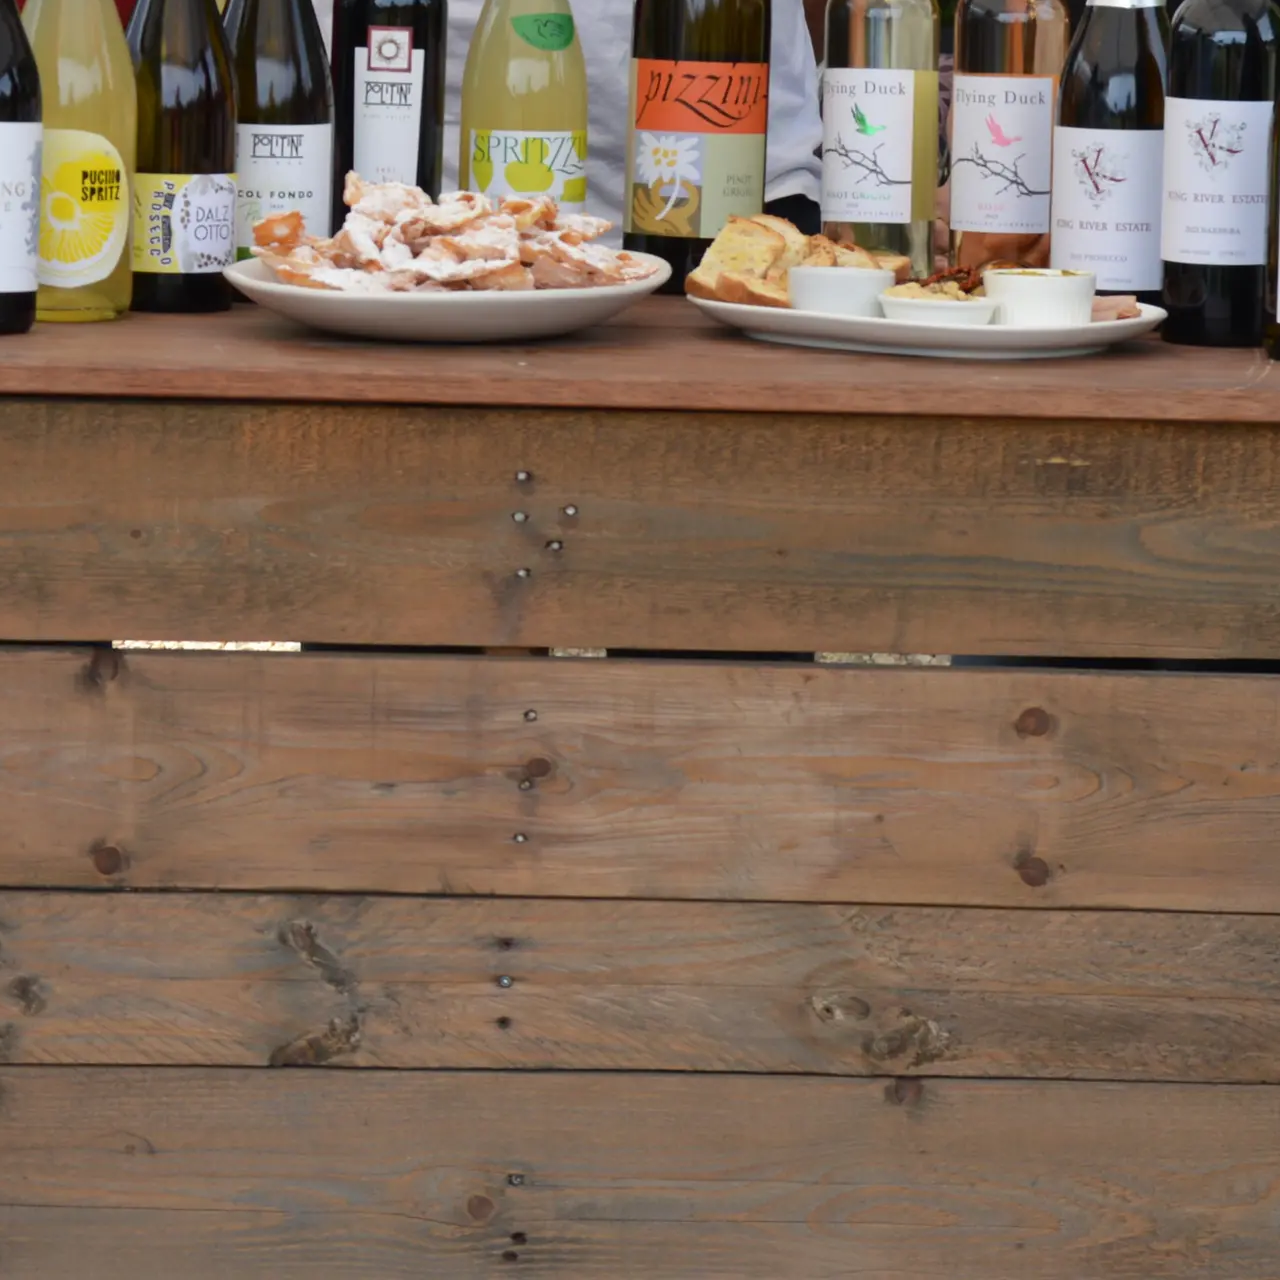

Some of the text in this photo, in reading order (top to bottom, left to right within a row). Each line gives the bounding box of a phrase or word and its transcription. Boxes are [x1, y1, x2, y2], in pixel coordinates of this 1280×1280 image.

[864, 80, 906, 95] Duck
[1004, 90, 1046, 105] Duck
[81, 169, 120, 185] PUCINO
[81, 185, 120, 202] SPRITZ
[237, 190, 313, 199] COL FONDO
[1193, 193, 1225, 204] RIVER
[194, 224, 230, 241] OTTO
[1079, 220, 1108, 231] RIVER
[1115, 222, 1152, 232] ESTATE
